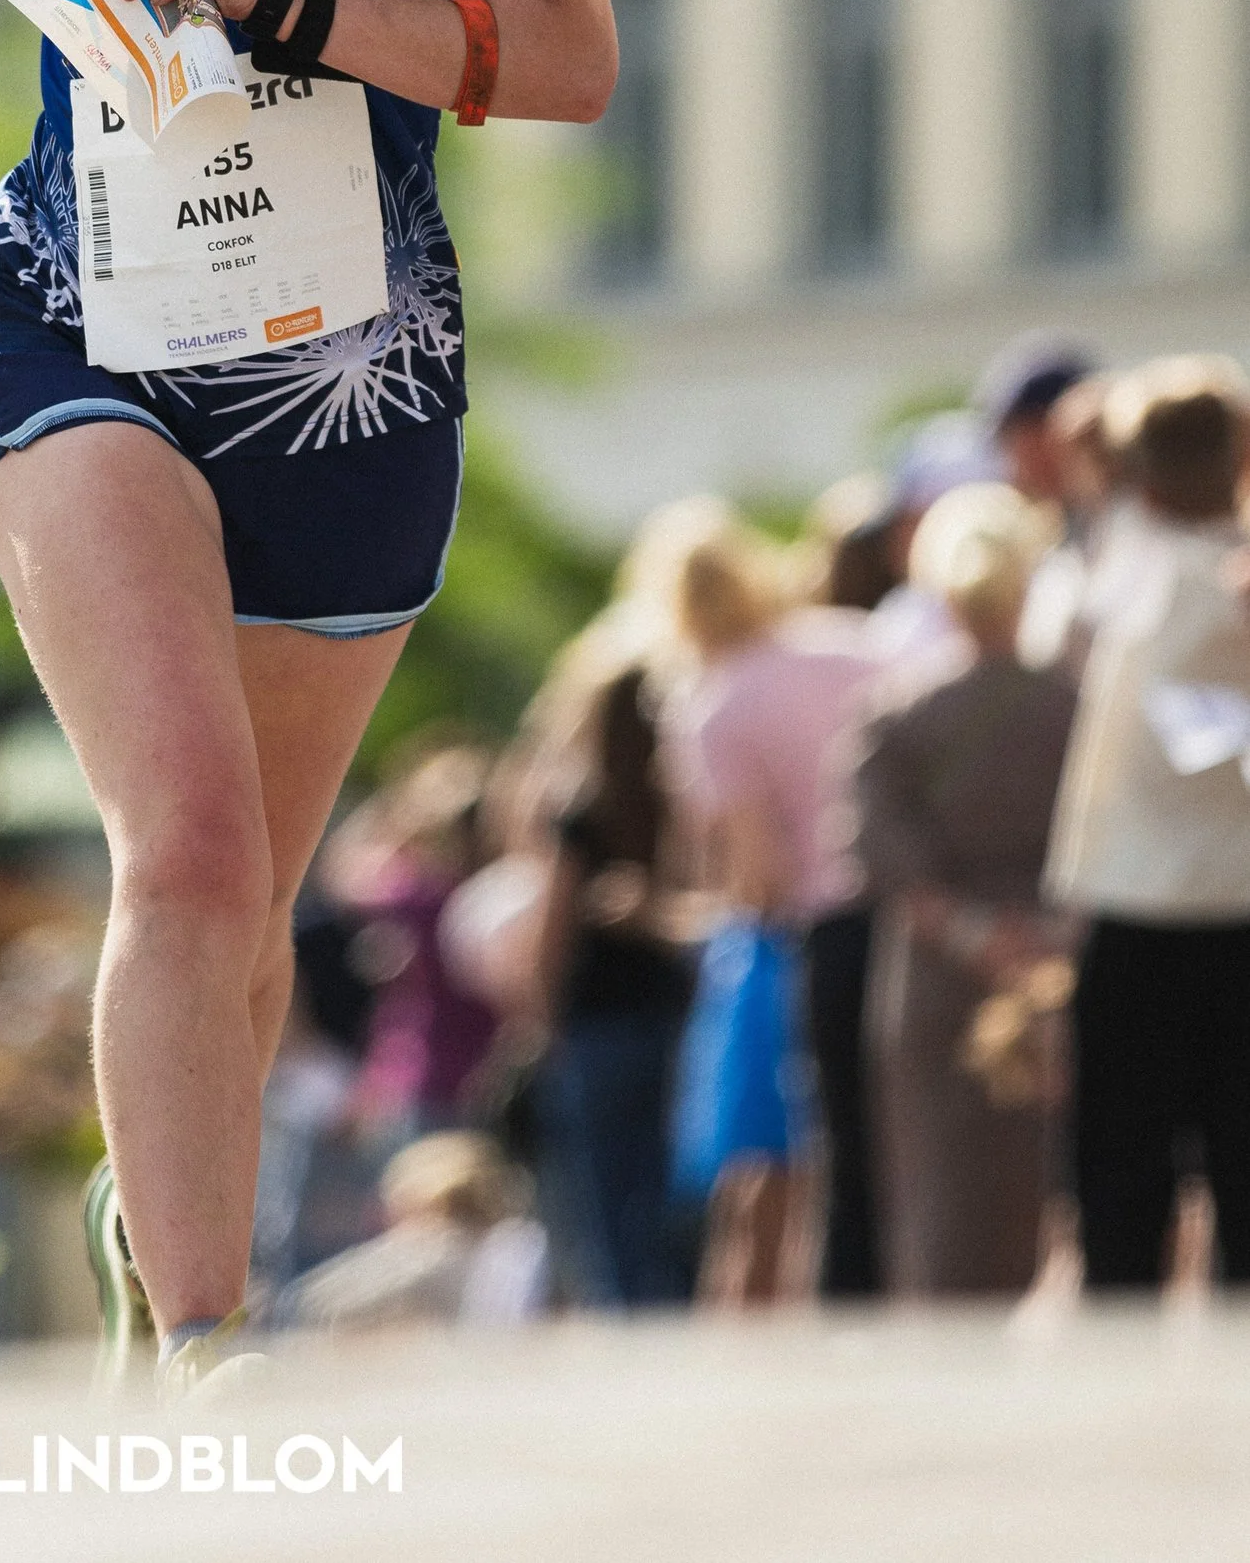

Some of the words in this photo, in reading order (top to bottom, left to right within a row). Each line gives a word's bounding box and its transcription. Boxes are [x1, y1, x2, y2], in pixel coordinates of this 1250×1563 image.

[177, 187, 275, 230] ANNA
[207, 234, 255, 252] COKFOK
[212, 260, 233, 273] D18
[235, 255, 258, 270] ELIT
[167, 327, 248, 351] CHALMERS
